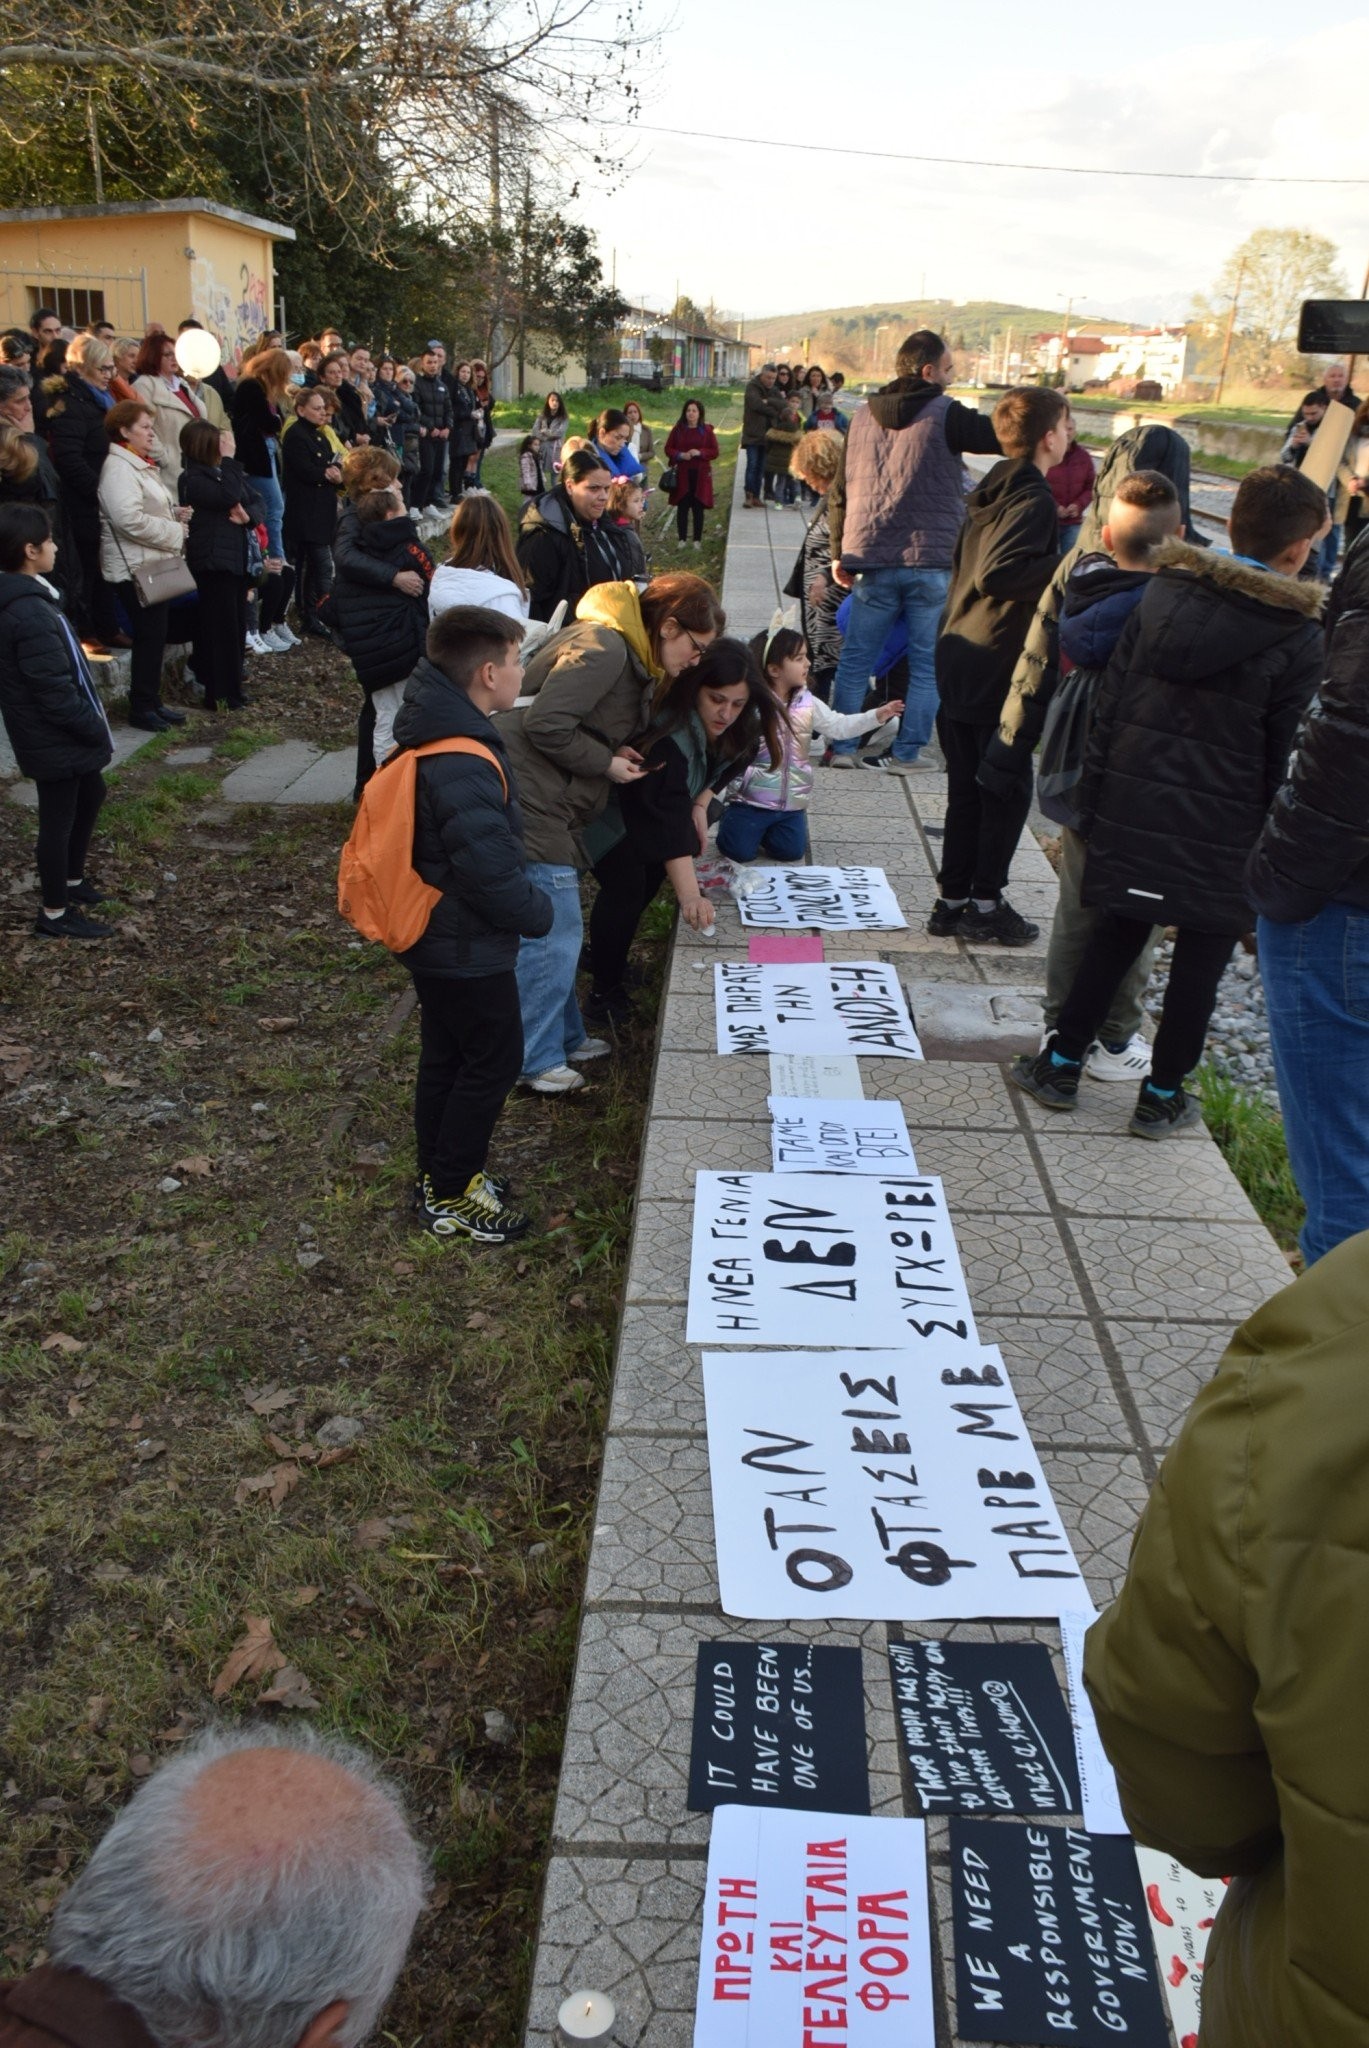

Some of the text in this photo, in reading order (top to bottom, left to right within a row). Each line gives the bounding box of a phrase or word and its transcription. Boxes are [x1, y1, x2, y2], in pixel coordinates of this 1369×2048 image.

[783, 870, 834, 892] ΜΟΥ
[722, 964, 769, 1054] ΜΑΣ ΠΗΡΑΤΕ
[773, 984, 816, 1023] ΤΗΝ
[830, 966, 915, 1053] ΑΝΟΙΞΗ
[774, 1116, 818, 1163] ΠΑΜΕ
[818, 1122, 858, 1168] ΚΑΙ ΟΠΟΥ
[853, 1127, 909, 1159] ΒΓΕΙ
[707, 1174, 761, 1331] Η ΝΕΑ ΓΕΝΙΑ
[762, 1199, 857, 1301] ΔΕΝ
[879, 1180, 968, 1339] ΣΥΓΧΩΡΕΙ
[741, 1428, 853, 1592] ΟΤΑΝ
[839, 1372, 977, 1586] ΦΤΑΣΕΙΣ
[940, 1363, 1080, 1578] ΠΑΡΕ ΜΕ
[707, 1661, 737, 1788] IT COULD
[751, 1645, 780, 1794] HAVE BEEN
[791, 1643, 819, 1790] ONE OF US....
[897, 1678, 920, 1702] had
[900, 1707, 932, 1747] people
[920, 1639, 986, 1810] to live their happy and
[989, 1698, 1031, 1740] shame
[908, 1754, 954, 1810] These
[946, 1686, 1015, 1810] carefree lives!!!
[1011, 1743, 1037, 1757] a
[1169, 1862, 1182, 1883] live
[1176, 1897, 1187, 1912] to
[1203, 1889, 1216, 1908] we
[713, 1878, 758, 2000] ΠΡΩΤΗ
[769, 1922, 804, 1972] ΚΑΙ
[855, 1890, 910, 2012] ΦΟΡΑ
[962, 1847, 1005, 2011] WE NEED
[1007, 1942, 1034, 1963] A
[1026, 1826, 1079, 2031] RESPONSIBLE
[1064, 1825, 1129, 2033] GOVERNMENT
[1102, 1897, 1148, 1982] NOW!
[1180, 1926, 1197, 1960] wants
